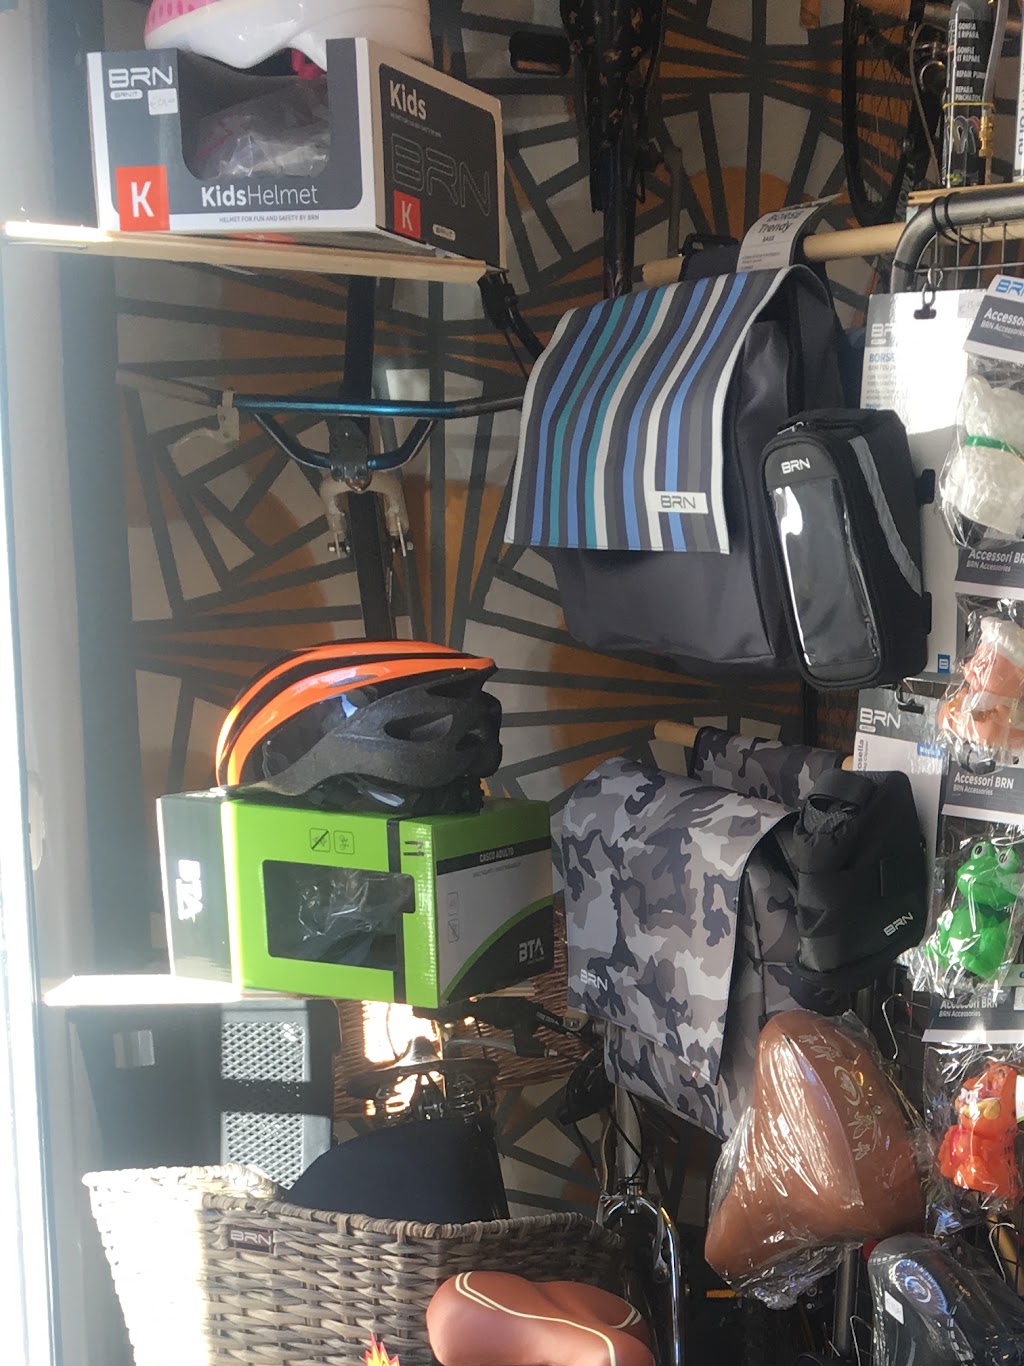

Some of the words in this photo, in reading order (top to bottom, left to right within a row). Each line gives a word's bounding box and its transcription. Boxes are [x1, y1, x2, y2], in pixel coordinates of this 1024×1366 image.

[108, 66, 173, 88] BRN
[389, 80, 427, 120] Kids
[392, 133, 490, 216] BRN
[131, 181, 154, 218] K
[201, 185, 319, 207] KidsHelmet
[402, 200, 413, 231] K
[759, 220, 793, 233] Trendy
[781, 457, 810, 473] BRN
[661, 495, 696, 510] BRN
[968, 549, 1014, 565] Accessori
[979, 562, 1011, 573] Accessories
[859, 708, 901, 729] BRN
[954, 772, 994, 787] Accessori
[994, 777, 1014, 789] BRN
[964, 786, 993, 796] Accessories
[884, 912, 914, 936] BRN
[519, 938, 544, 963] BTA
[950, 1010, 981, 1018] Accessories
[230, 1229, 272, 1247] BRN
